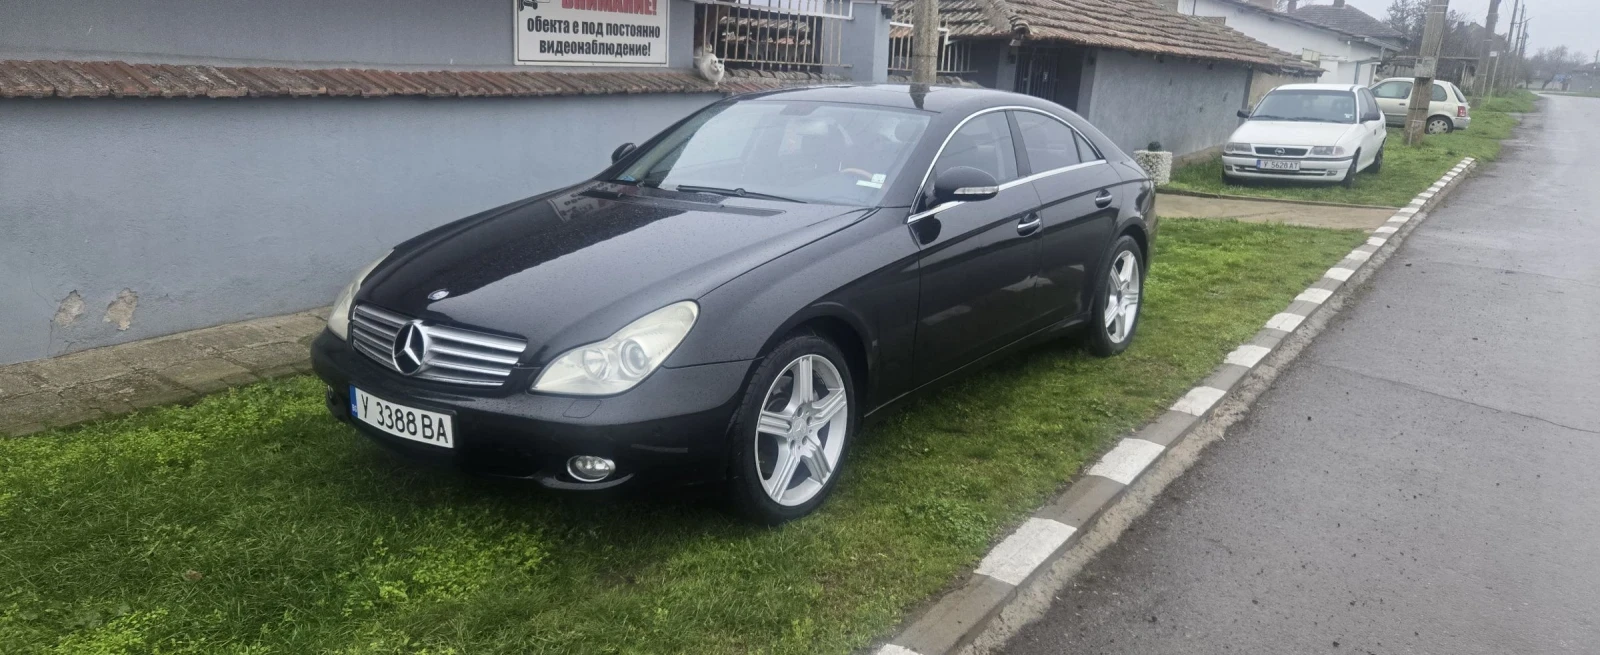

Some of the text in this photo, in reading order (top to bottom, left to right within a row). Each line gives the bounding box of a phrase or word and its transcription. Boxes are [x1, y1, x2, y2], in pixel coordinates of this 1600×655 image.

[527, 16, 660, 38] обекта е под постоянно
[539, 40, 651, 57] видеонаблюдение!
[361, 394, 448, 443] Y 3388 BA
